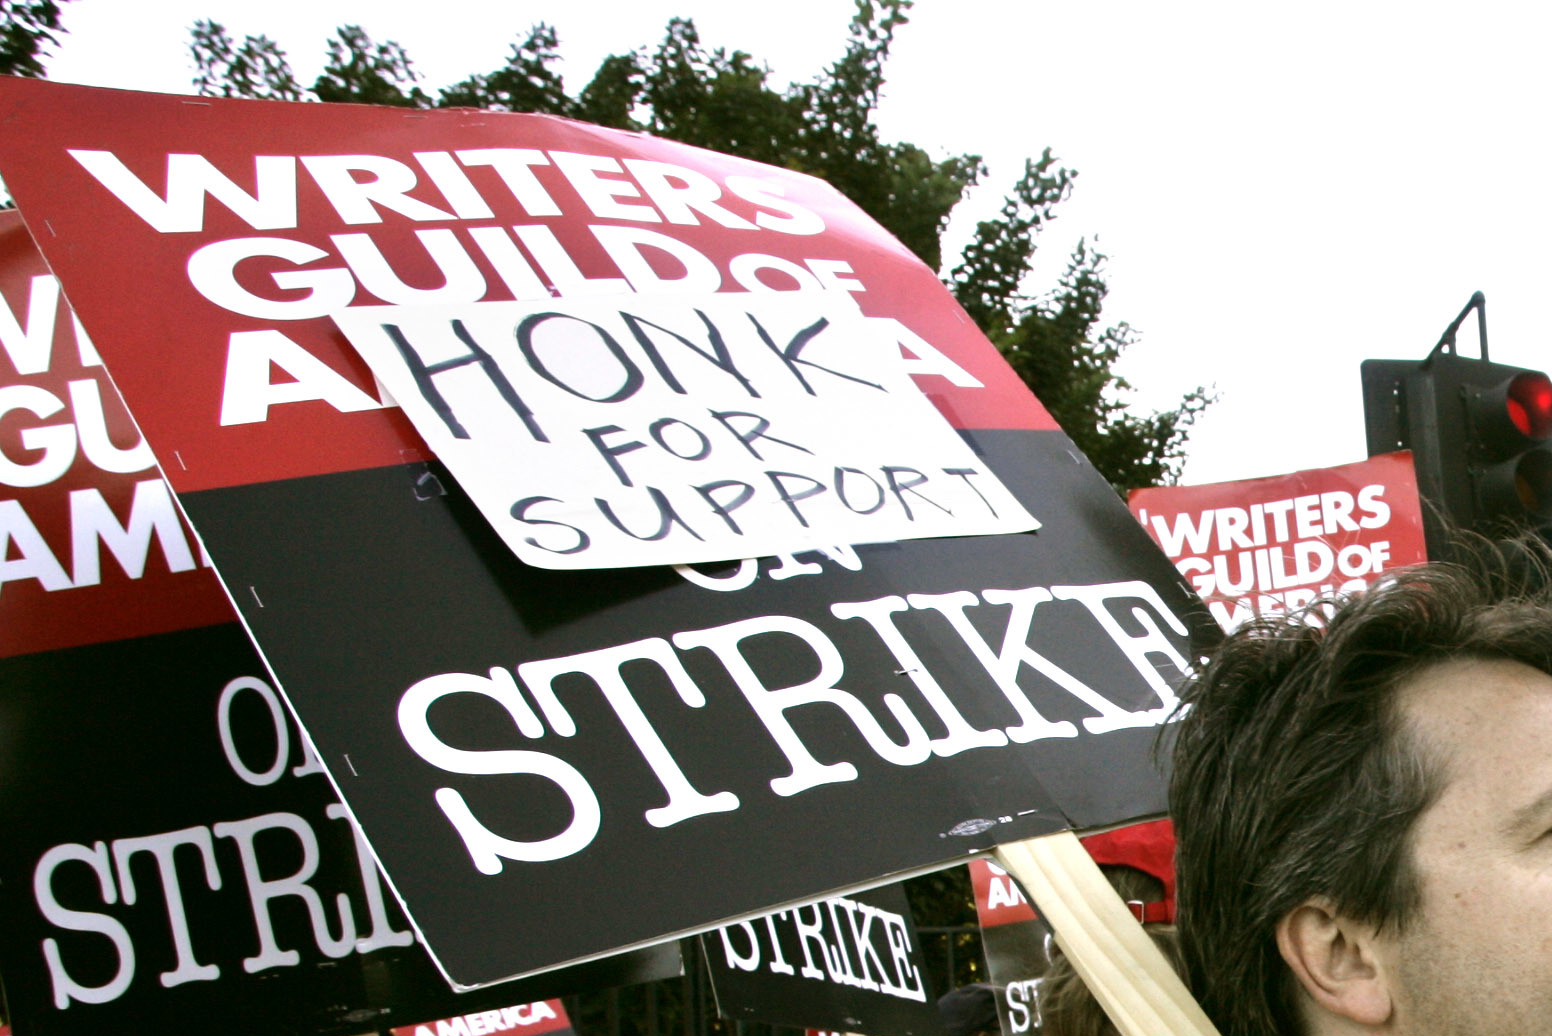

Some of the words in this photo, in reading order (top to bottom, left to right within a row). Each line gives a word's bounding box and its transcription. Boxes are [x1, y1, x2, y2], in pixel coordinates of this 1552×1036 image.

[66, 147, 826, 236] WRITERS
[186, 223, 722, 321] GUILD
[729, 252, 867, 296] OF
[380, 308, 890, 443] HONK
[580, 408, 815, 487] FOR
[509, 466, 1000, 555] SUPPORT
[1150, 484, 1391, 558] WRITERS
[1175, 540, 1335, 598] GUILD
[1337, 540, 1391, 578] OF
[397, 579, 1197, 876] STRIKE
[33, 802, 424, 1010] STRI
